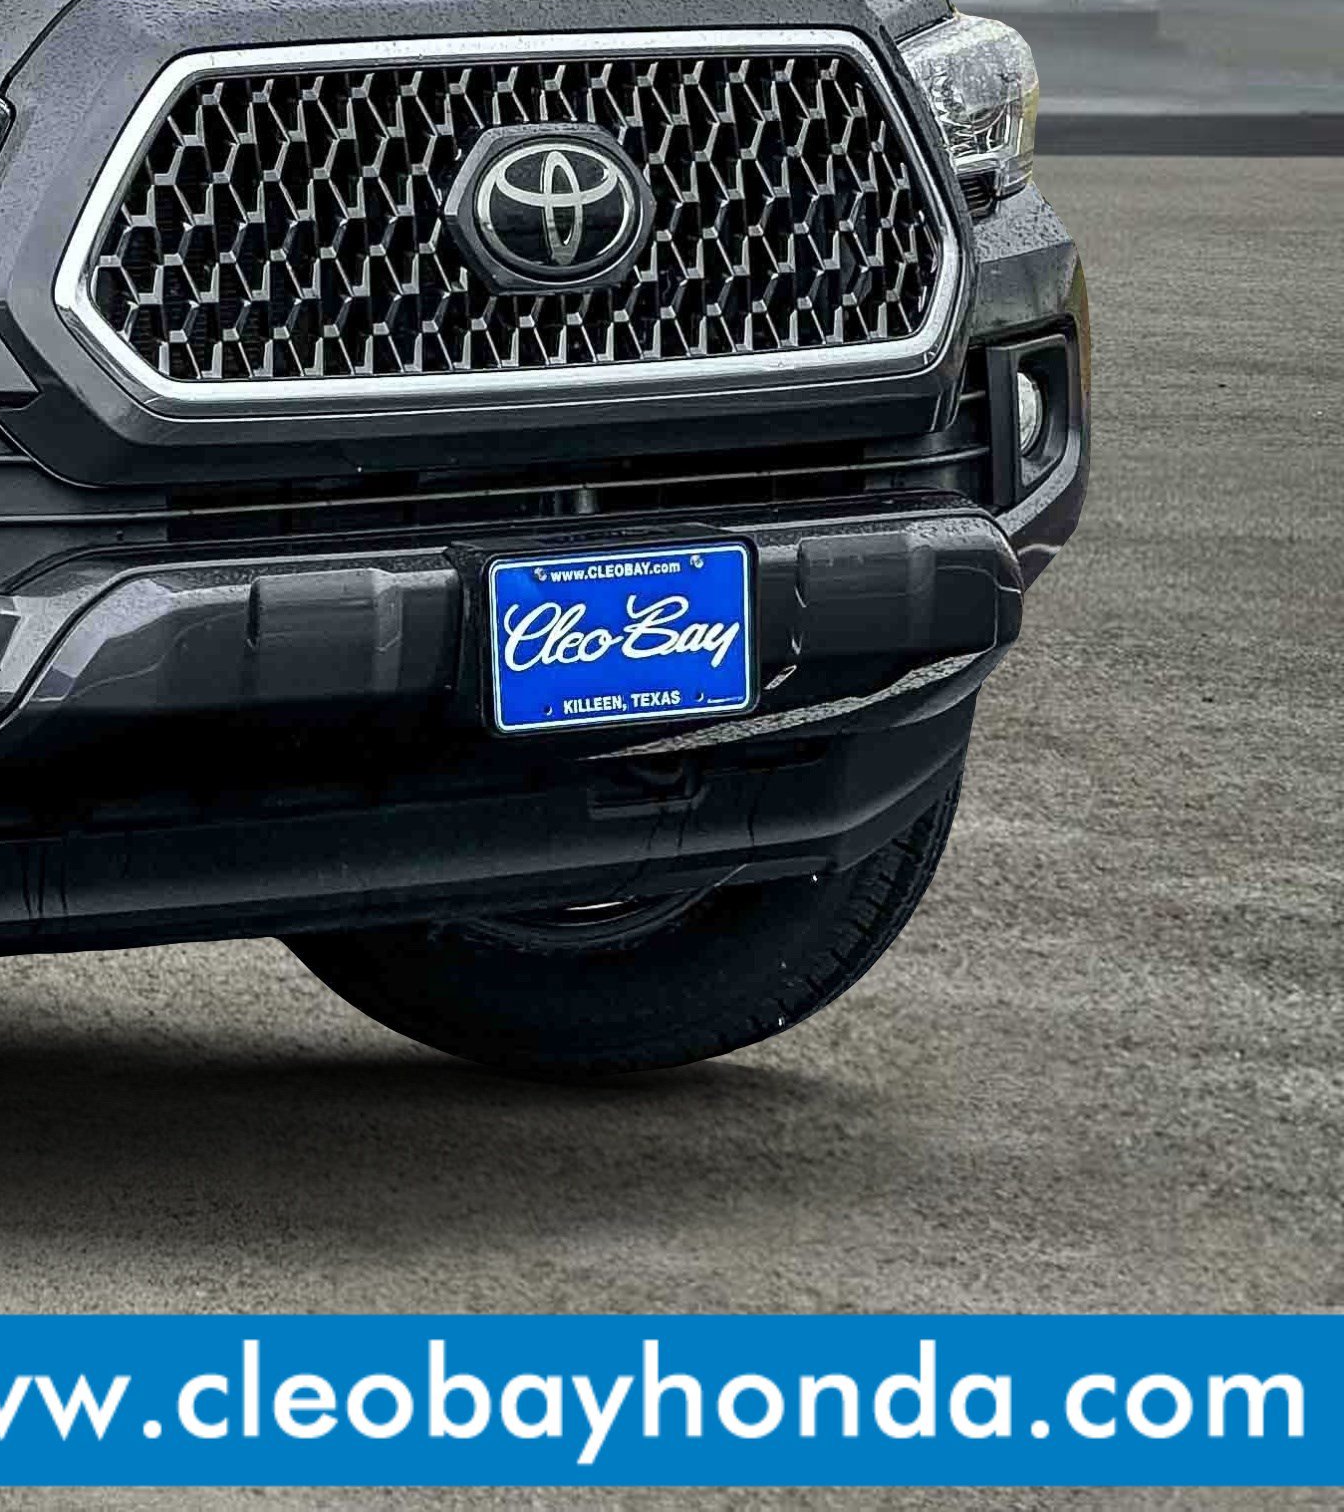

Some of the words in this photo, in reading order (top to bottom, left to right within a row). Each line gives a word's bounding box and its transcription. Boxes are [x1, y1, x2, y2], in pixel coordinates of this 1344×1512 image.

[551, 561, 681, 582] www.CLEOBAY.com
[504, 601, 623, 672] Cleo
[620, 595, 740, 668] Bay
[563, 695, 628, 715] KILLEEN,
[631, 690, 681, 708] TEXAS
